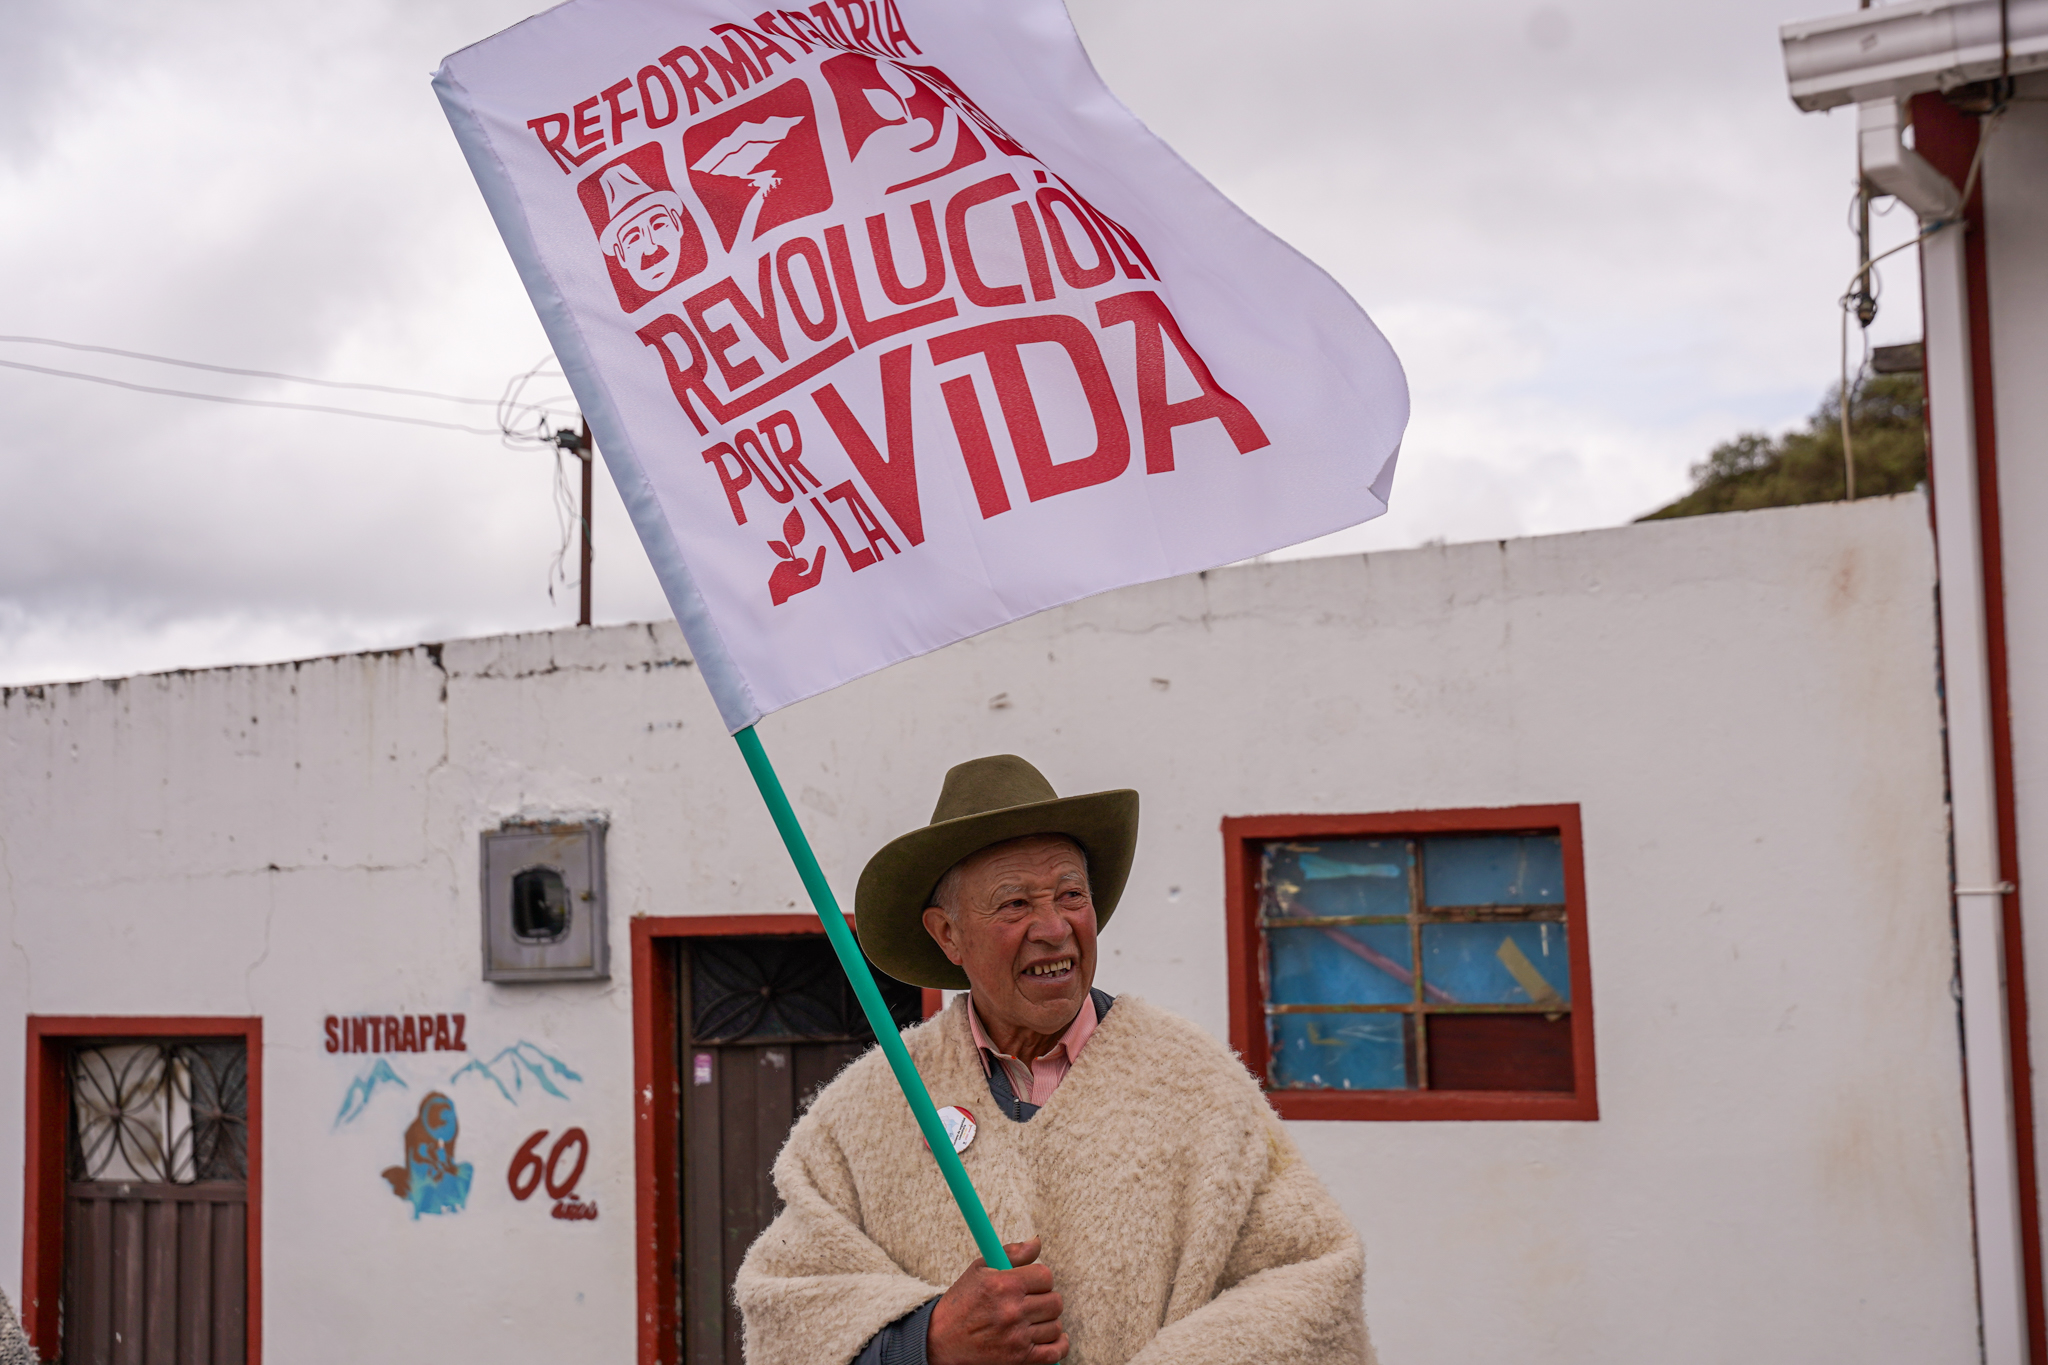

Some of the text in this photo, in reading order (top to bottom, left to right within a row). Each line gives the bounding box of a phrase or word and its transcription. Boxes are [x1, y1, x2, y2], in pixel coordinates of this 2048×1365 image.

[527, 23, 797, 174] REFORMA
[635, 168, 1162, 434] REVOLUCIÓN
[703, 409, 822, 525] POR
[811, 290, 1271, 549] VIDA
[810, 479, 901, 572] LA
[325, 1013, 467, 1053] SINTRAPAZ
[508, 1127, 589, 1201] 60
